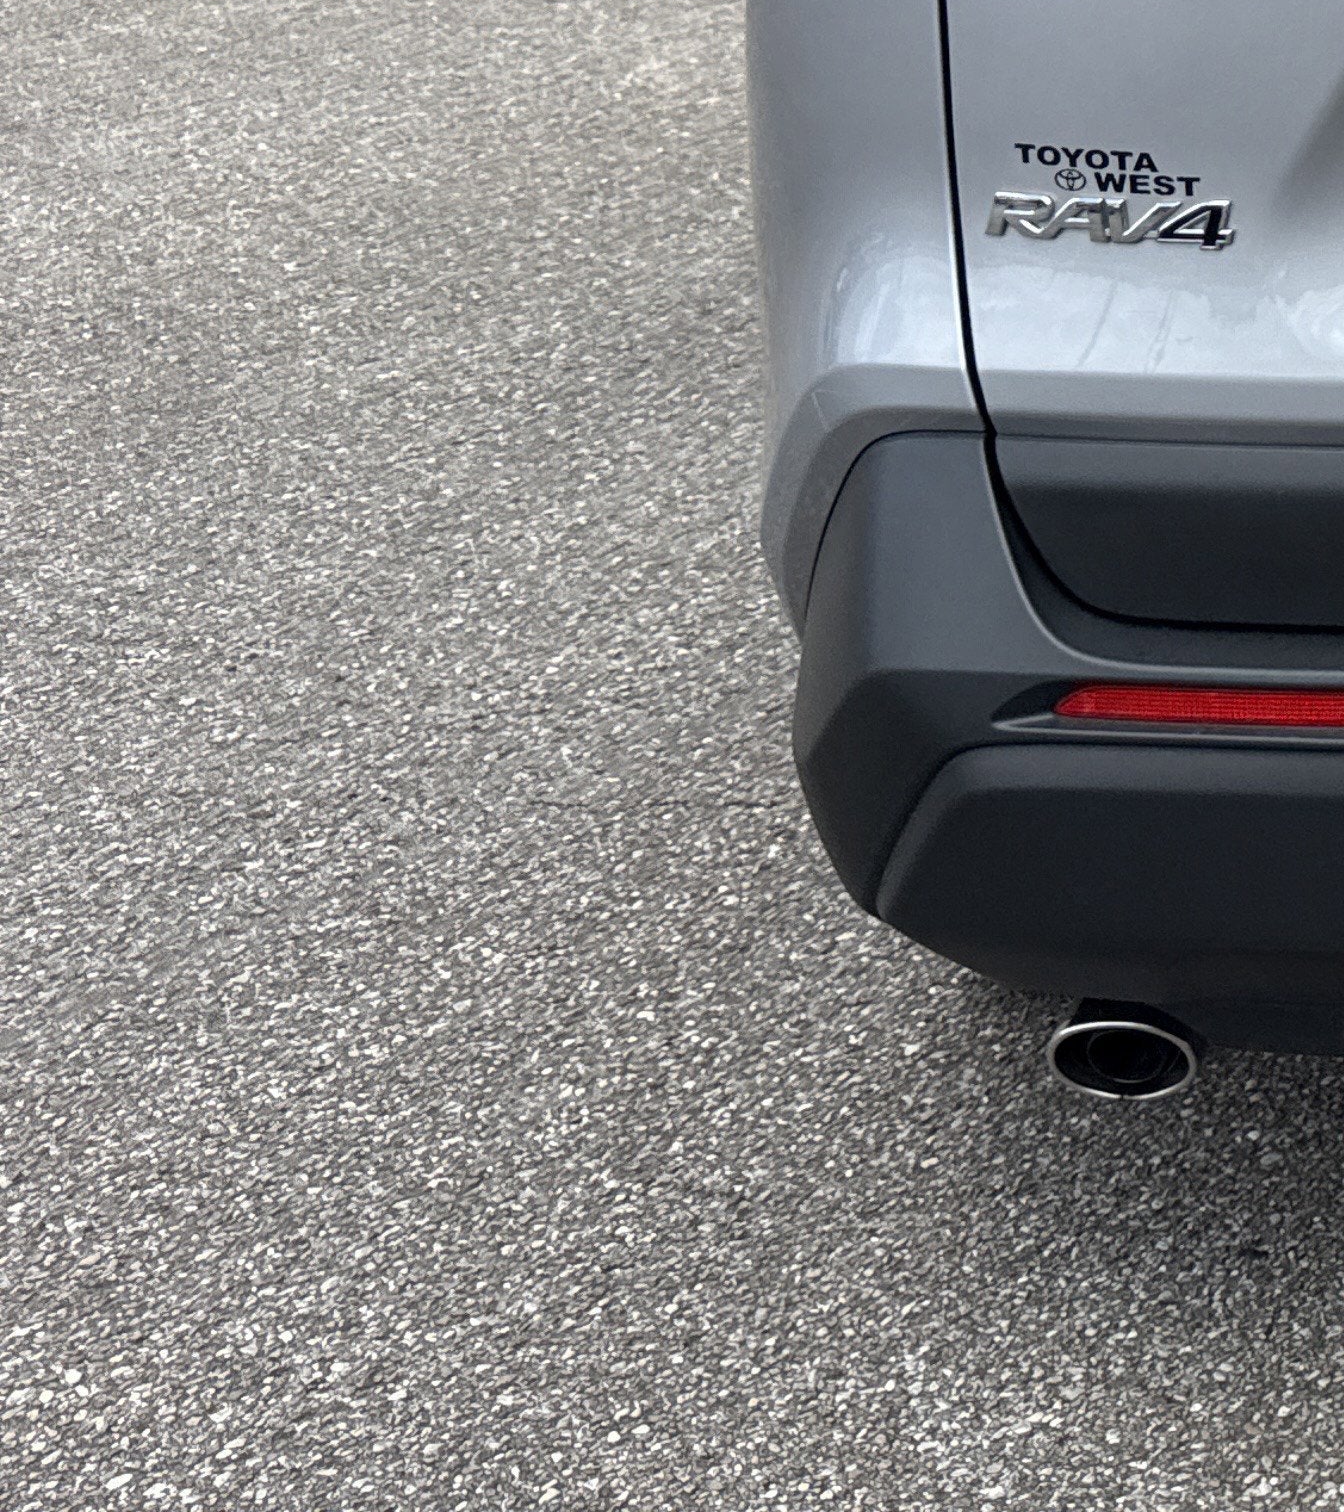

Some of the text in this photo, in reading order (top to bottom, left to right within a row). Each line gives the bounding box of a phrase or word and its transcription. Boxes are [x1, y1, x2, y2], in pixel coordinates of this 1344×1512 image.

[1014, 142, 1159, 173] TOYOTA
[1093, 172, 1201, 196] WEST
[984, 190, 1236, 251] RAV4
